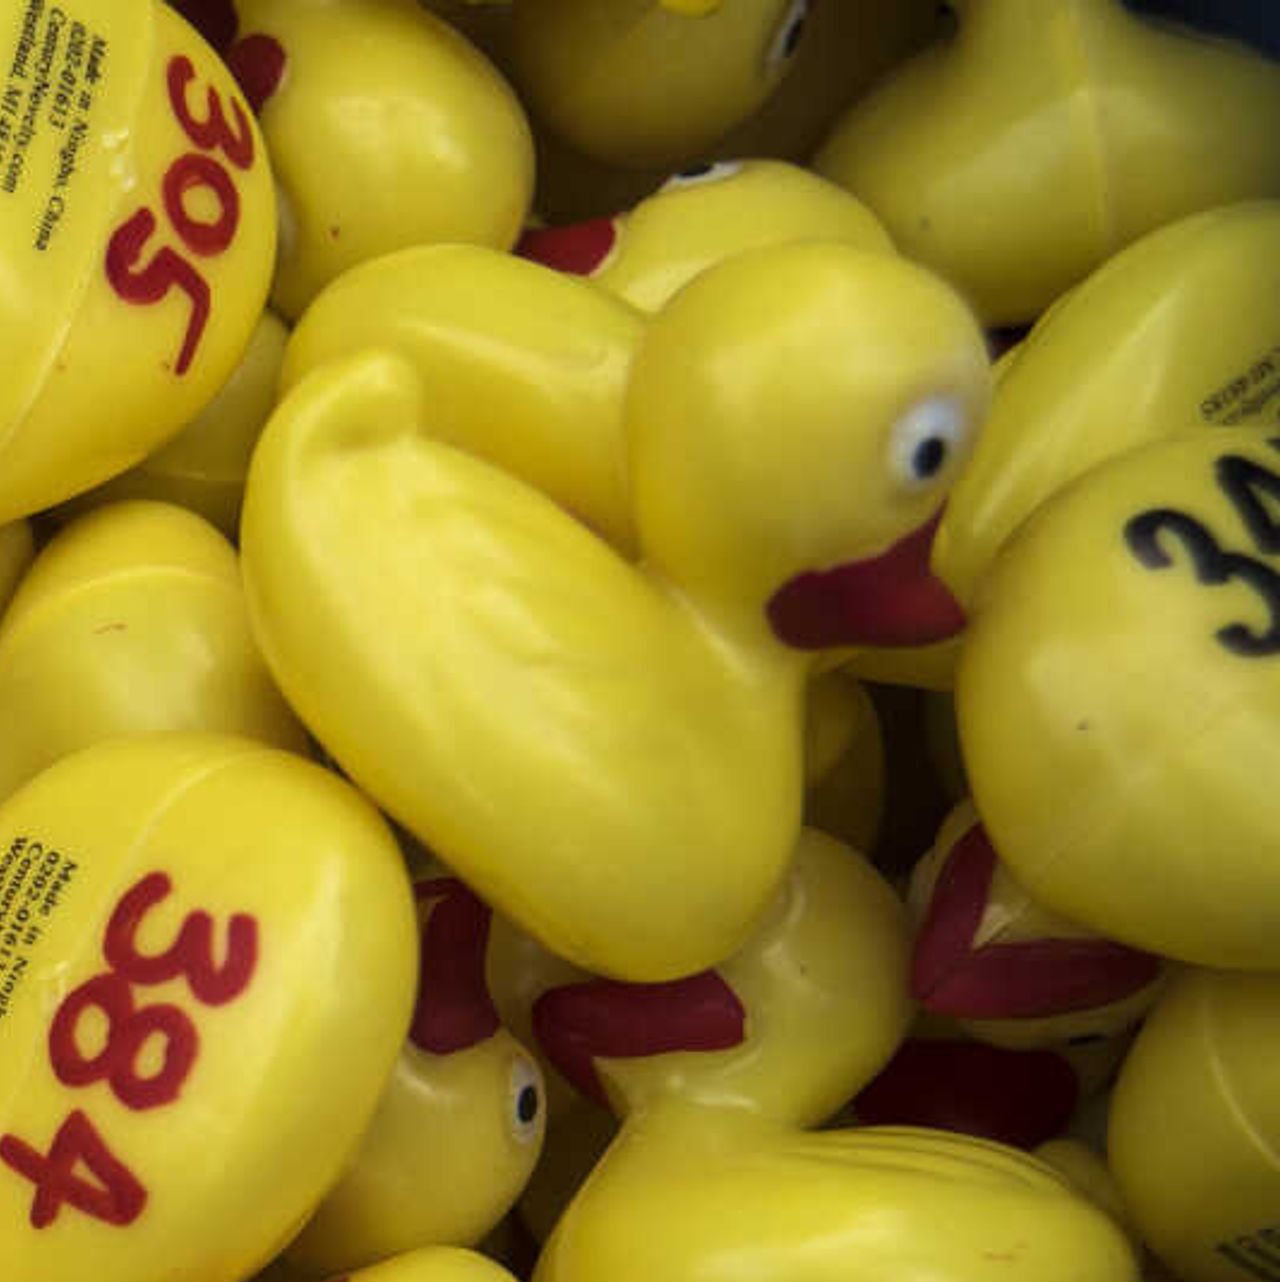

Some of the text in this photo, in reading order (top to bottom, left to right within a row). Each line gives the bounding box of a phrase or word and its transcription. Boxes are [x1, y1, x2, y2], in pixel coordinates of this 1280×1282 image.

[83, 35, 106, 85] Made
[34, 195, 64, 251] China
[104, 55, 255, 376] 305
[38, 859, 78, 916] Made
